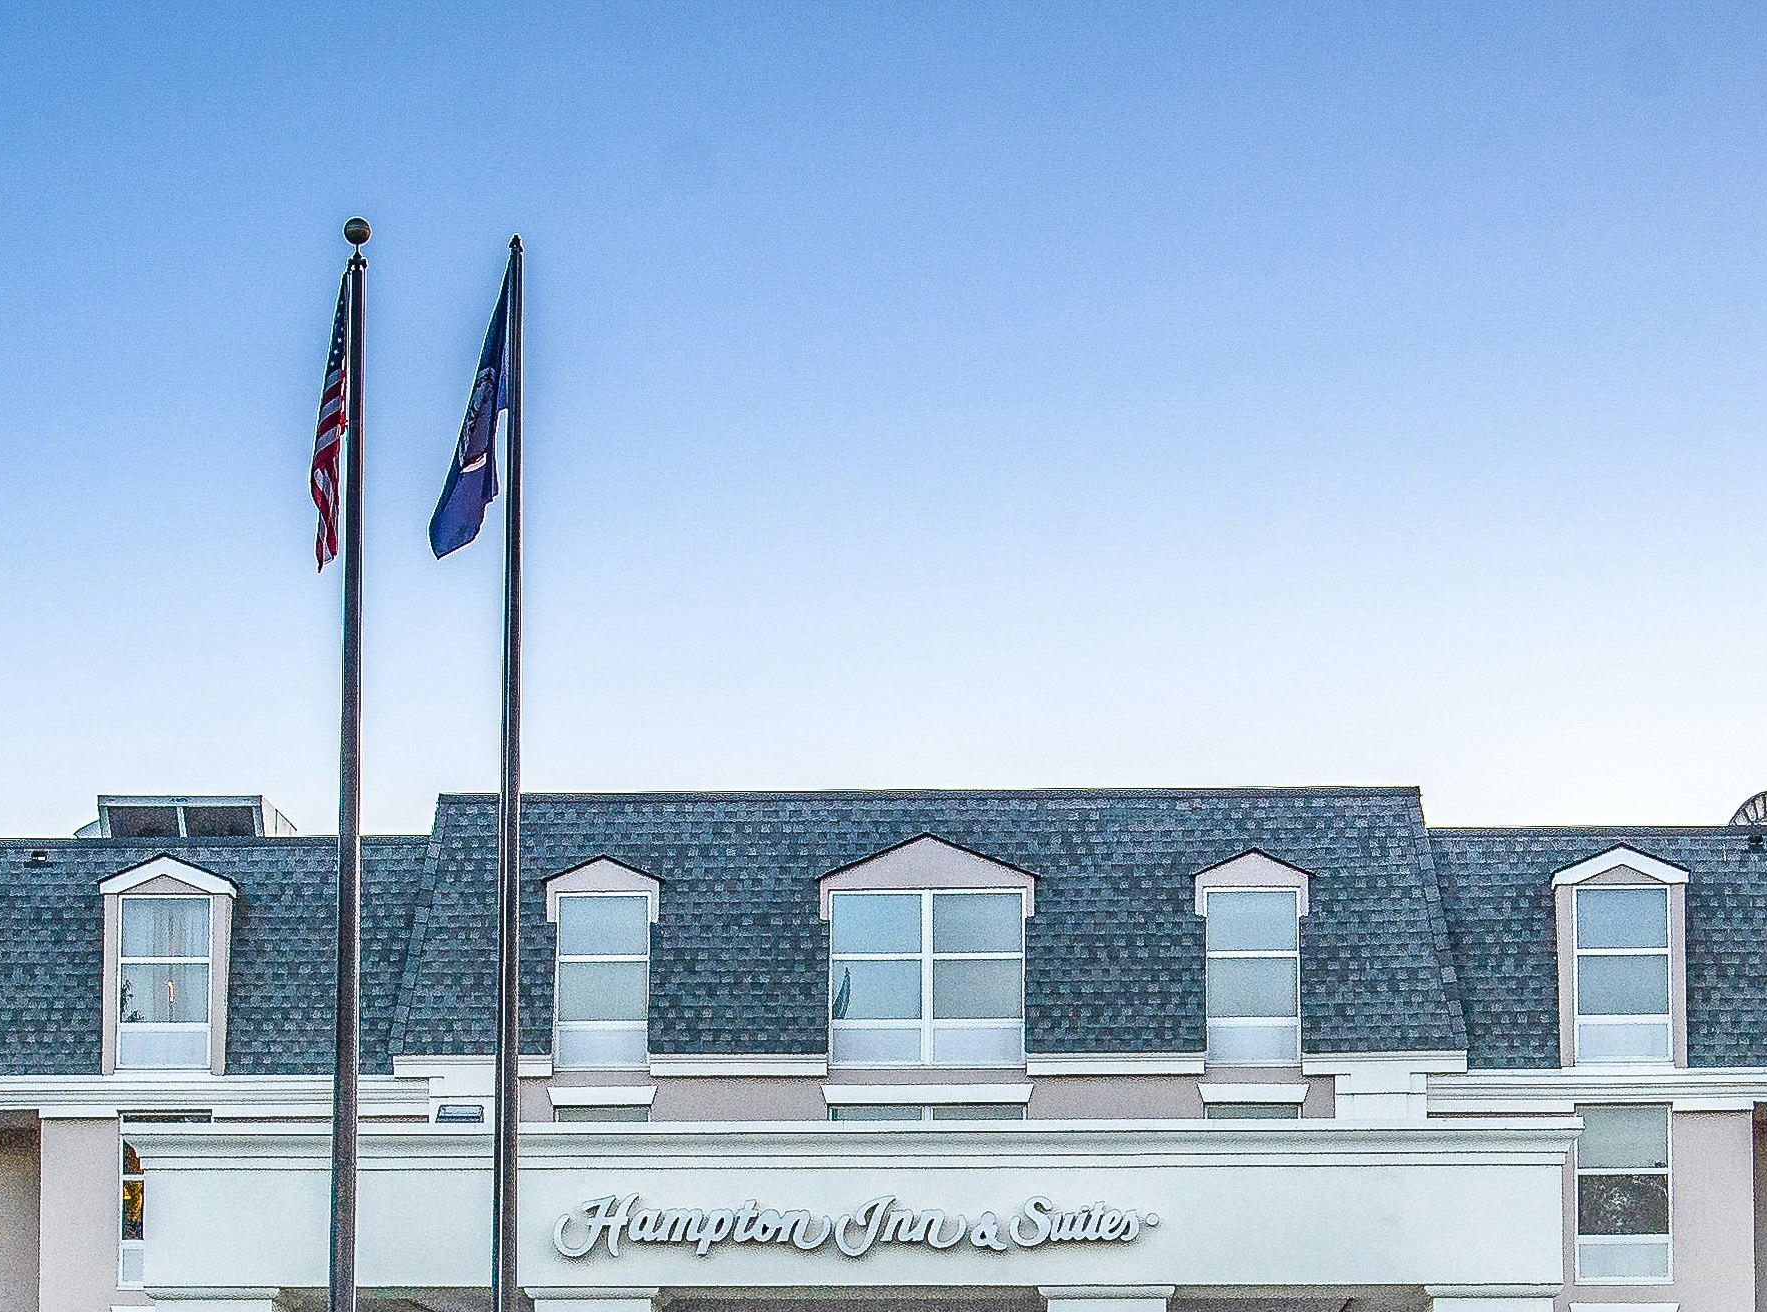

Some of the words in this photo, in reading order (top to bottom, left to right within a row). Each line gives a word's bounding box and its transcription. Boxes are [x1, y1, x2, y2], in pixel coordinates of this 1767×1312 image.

[553, 1193, 833, 1259] Hampton
[833, 1194, 967, 1258] Inn
[970, 1211, 1008, 1252] &
[1010, 1195, 1141, 1249] Suites
